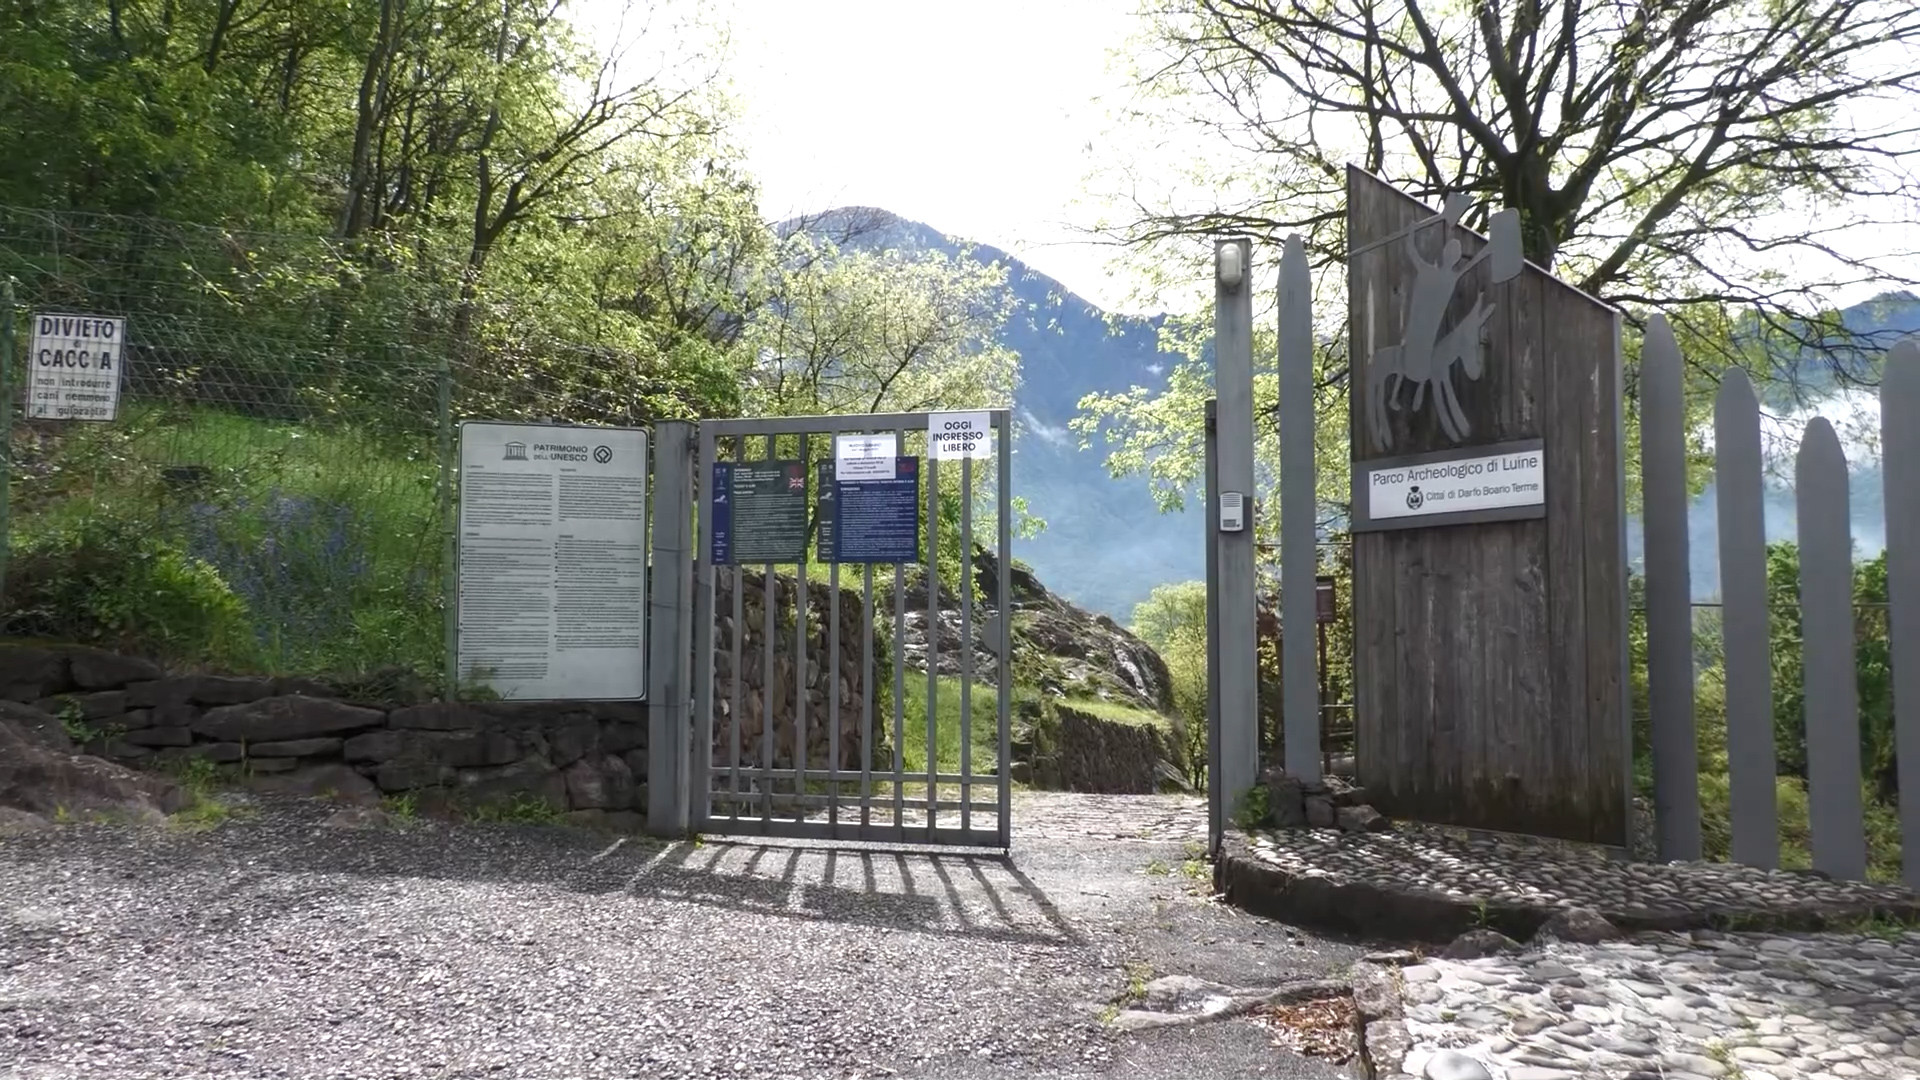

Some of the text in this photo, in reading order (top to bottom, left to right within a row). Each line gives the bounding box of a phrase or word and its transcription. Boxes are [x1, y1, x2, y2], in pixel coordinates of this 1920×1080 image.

[40, 317, 114, 338] DIVIETO
[944, 421, 972, 430] OGGI
[932, 431, 984, 442] INGRESSO
[533, 443, 589, 454] PATRIMONIO
[943, 442, 981, 452] LIBERO
[1373, 456, 1538, 486] Parco Archeologico di Luine
[1448, 491, 1456, 500] di
[1458, 487, 1482, 499] Darfo
[1483, 484, 1511, 497] Boario
[1512, 482, 1539, 493] Terme
